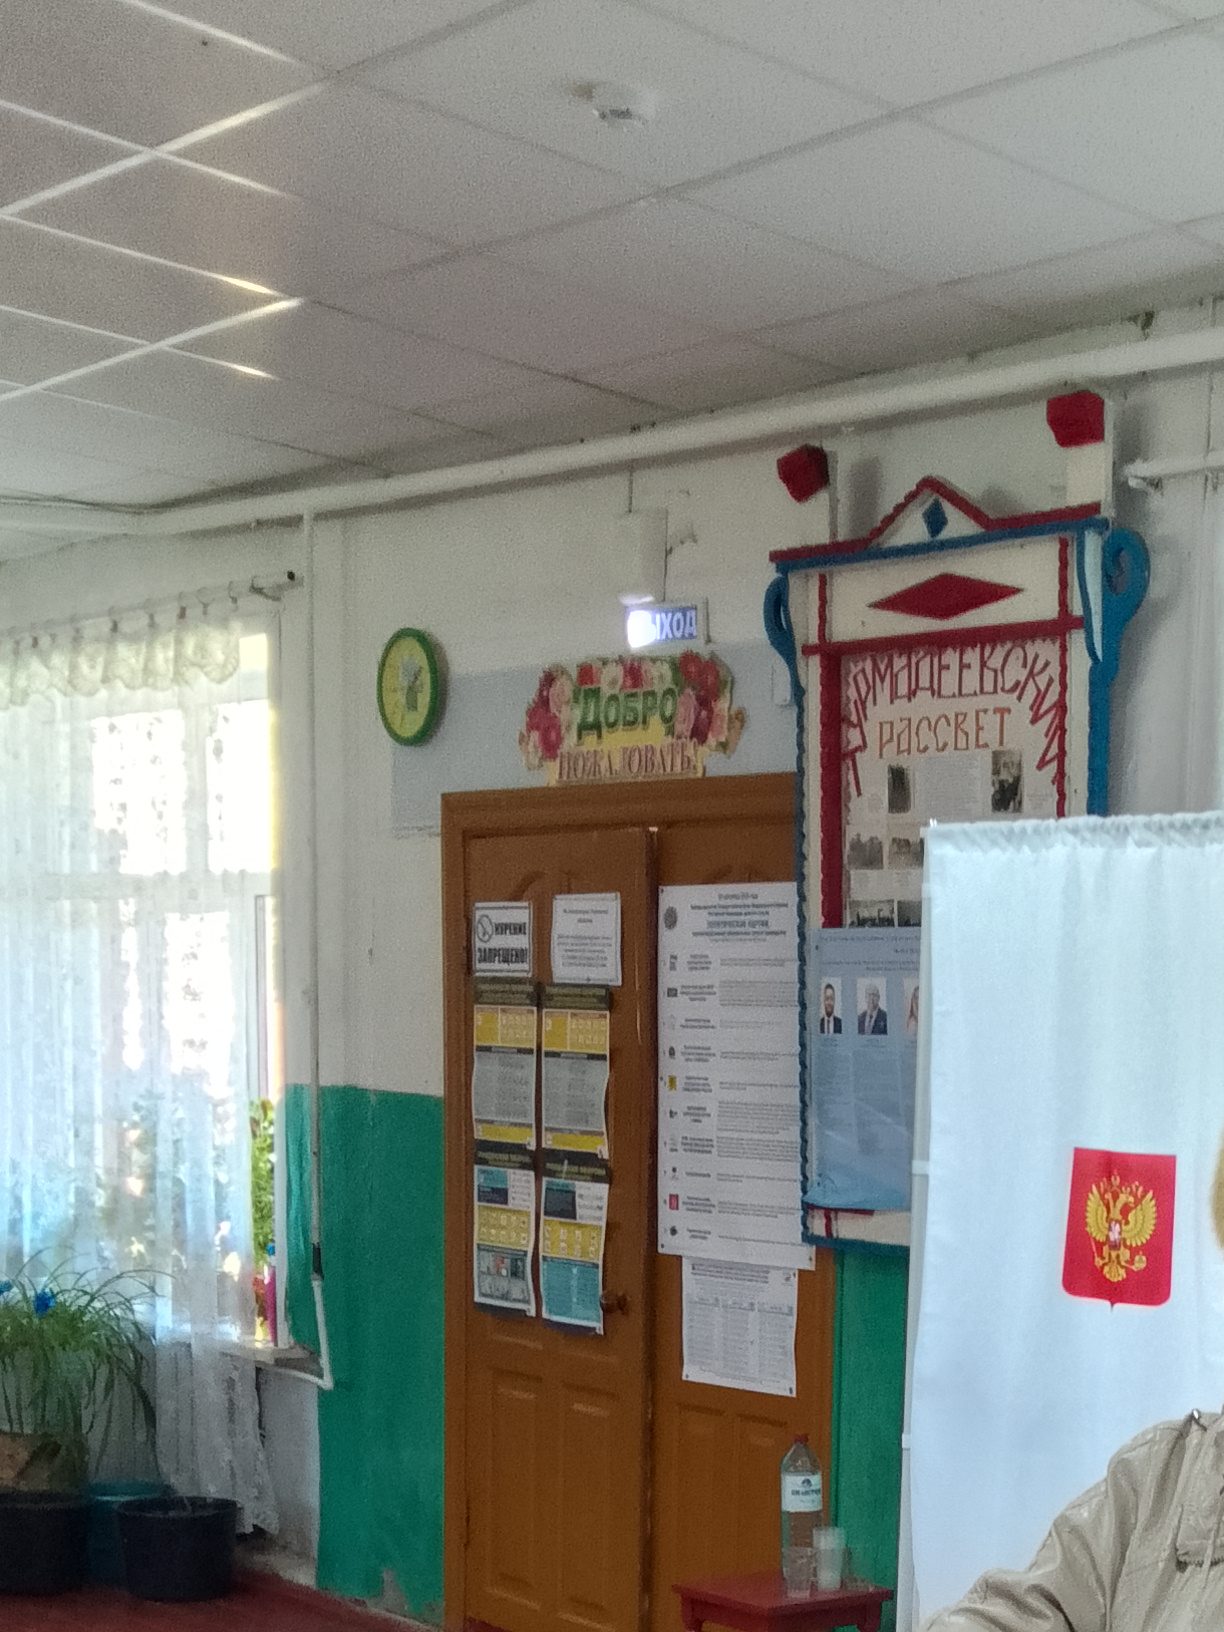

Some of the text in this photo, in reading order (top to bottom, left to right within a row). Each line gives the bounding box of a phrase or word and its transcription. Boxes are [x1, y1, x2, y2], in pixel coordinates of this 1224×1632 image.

[577, 687, 677, 744] ДОБРО
[878, 706, 1012, 758] РАССВЕТ
[494, 922, 527, 935] КУРЕНИЕ
[477, 946, 528, 965] ЗАПРЕЩЕНО!
